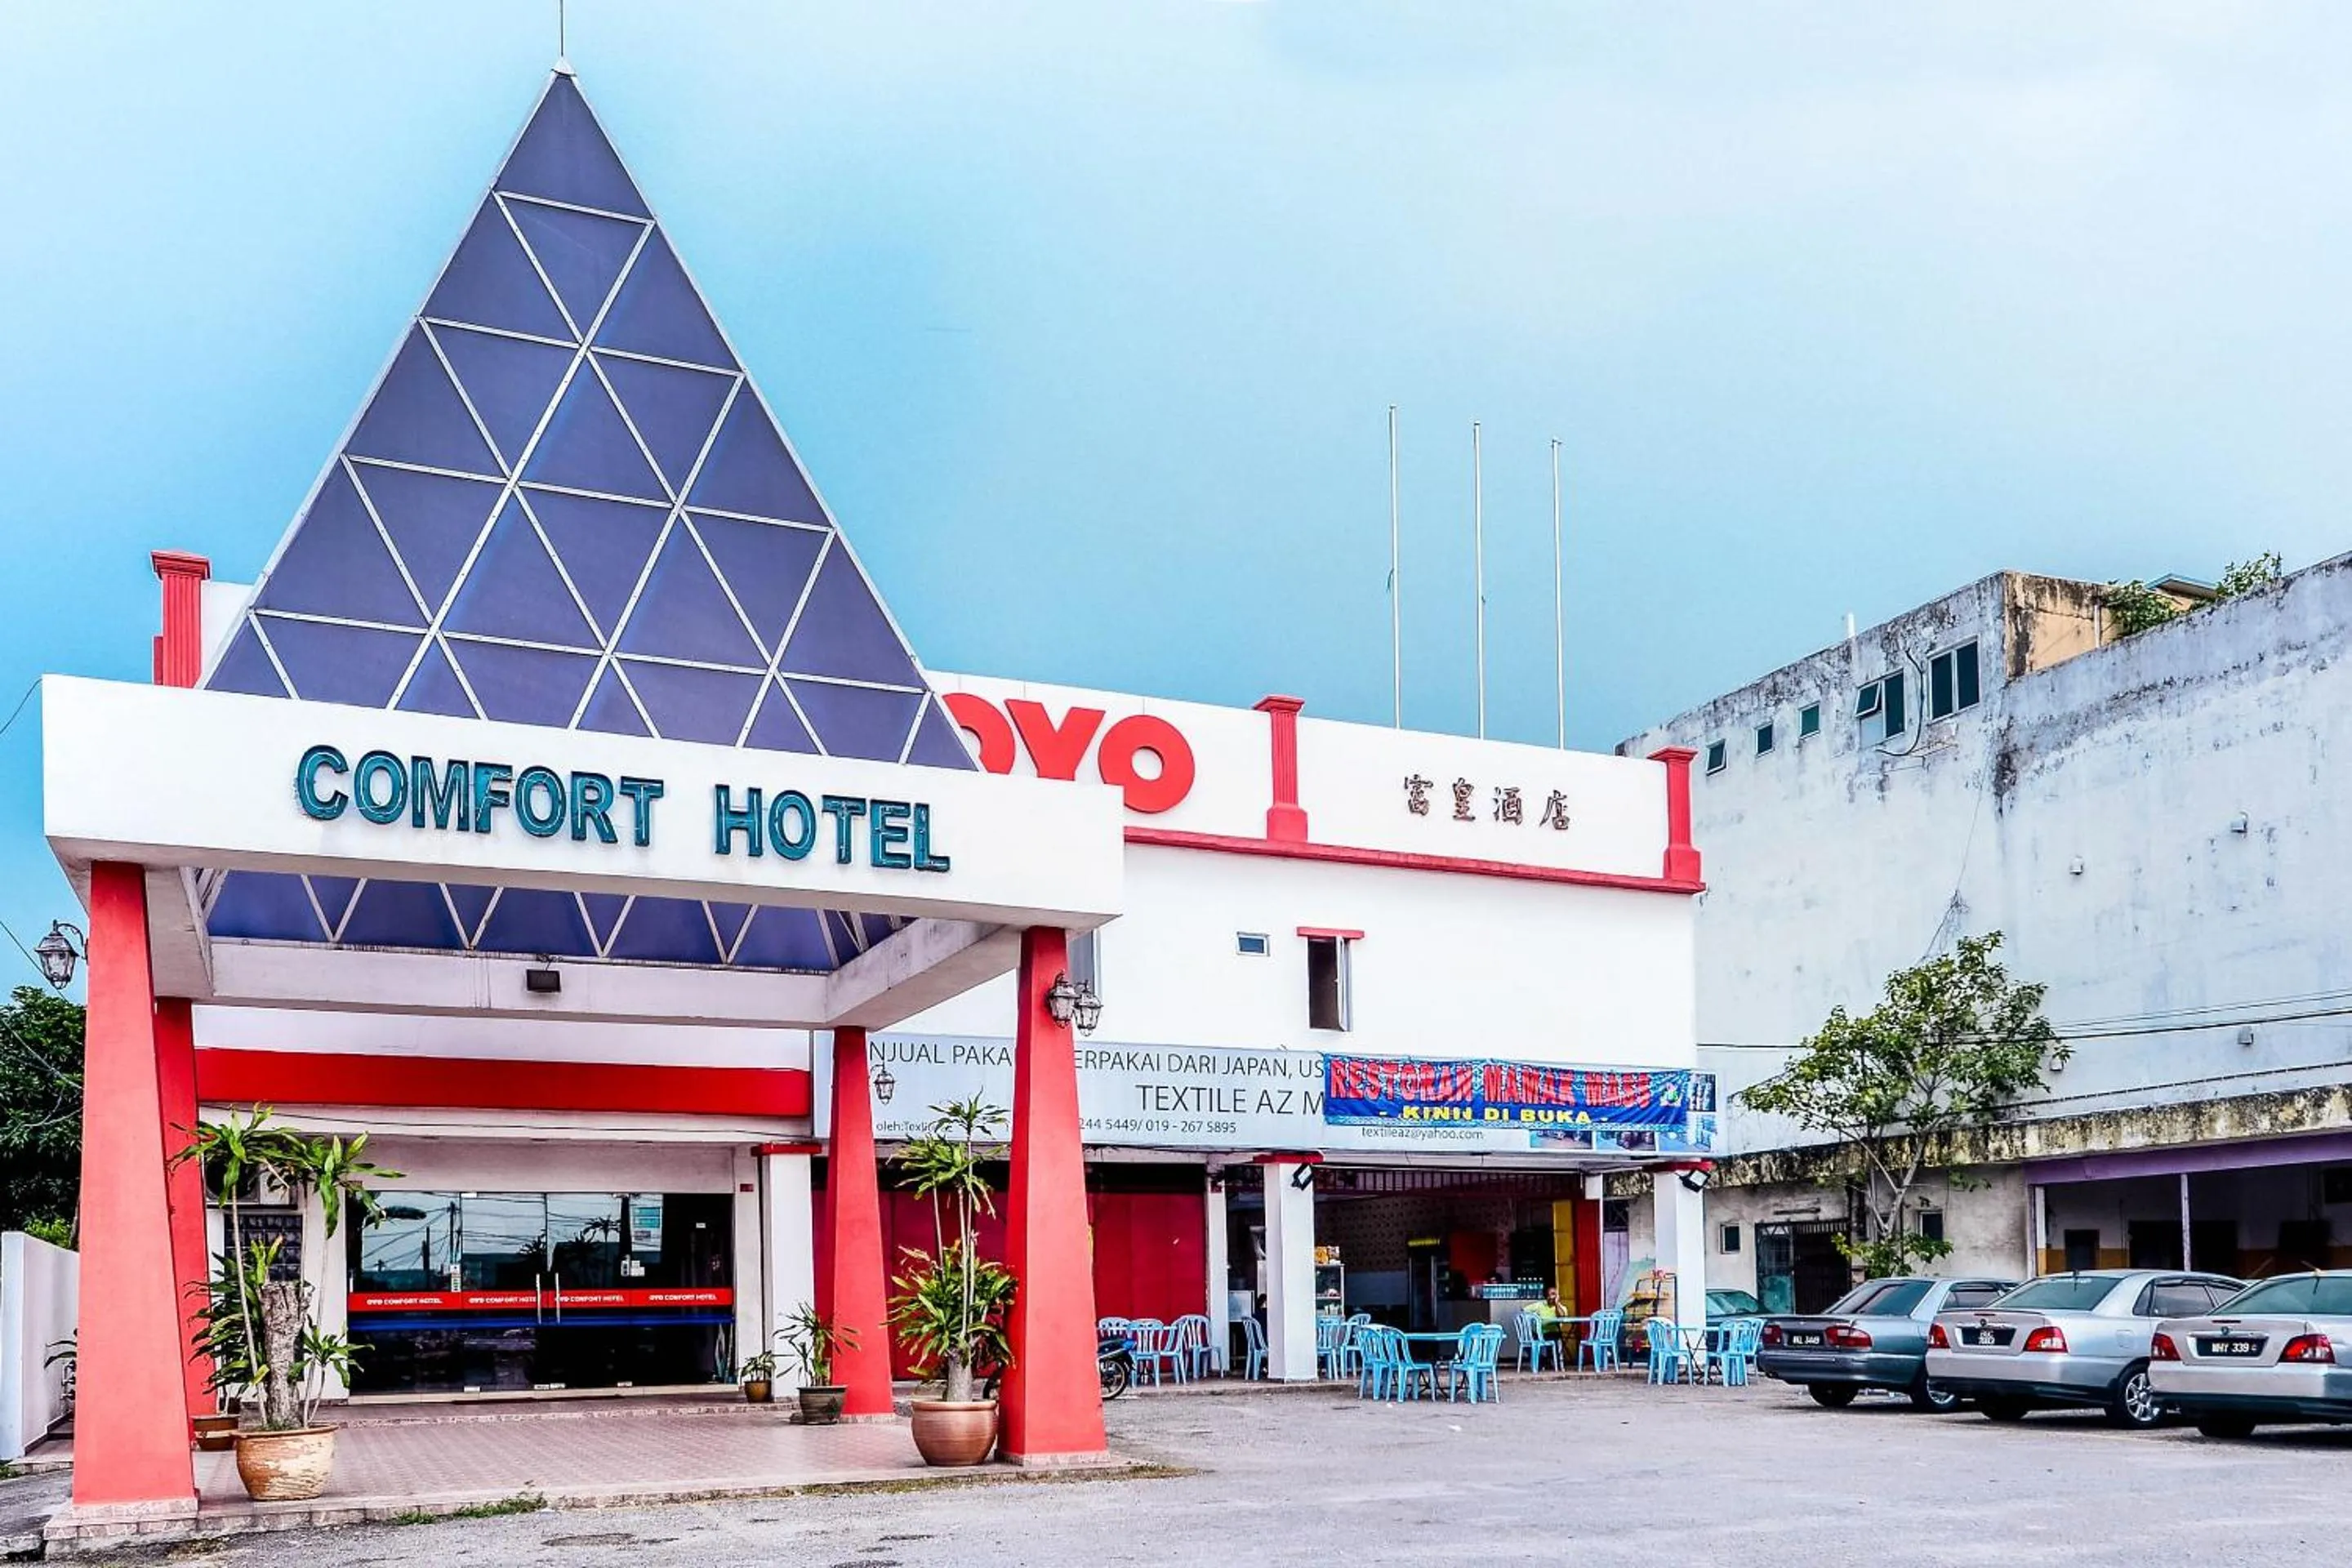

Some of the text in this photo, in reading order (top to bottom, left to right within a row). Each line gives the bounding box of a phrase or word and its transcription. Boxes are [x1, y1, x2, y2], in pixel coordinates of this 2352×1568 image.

[296, 744, 951, 873] COMFORT HOTEL
[1404, 774, 1570, 831] 富皇酒店
[869, 1041, 1324, 1079] NJUAL PAKA ERPAKAI DARI JAPAN, US
[1135, 1084, 1247, 1113] TEXTILE
[1256, 1089, 1294, 1116] AZ
[1330, 1058, 1474, 1102] RESTORAN
[1483, 1064, 1576, 1107] MAMAK
[1146, 1120, 1169, 1131] 019
[1181, 1120, 1203, 1133] 267
[1207, 1121, 1236, 1134] 5895
[1484, 1107, 1509, 1121] DI
[1520, 1108, 1592, 1125] BUKA
[2232, 1342, 2250, 1353] 339
